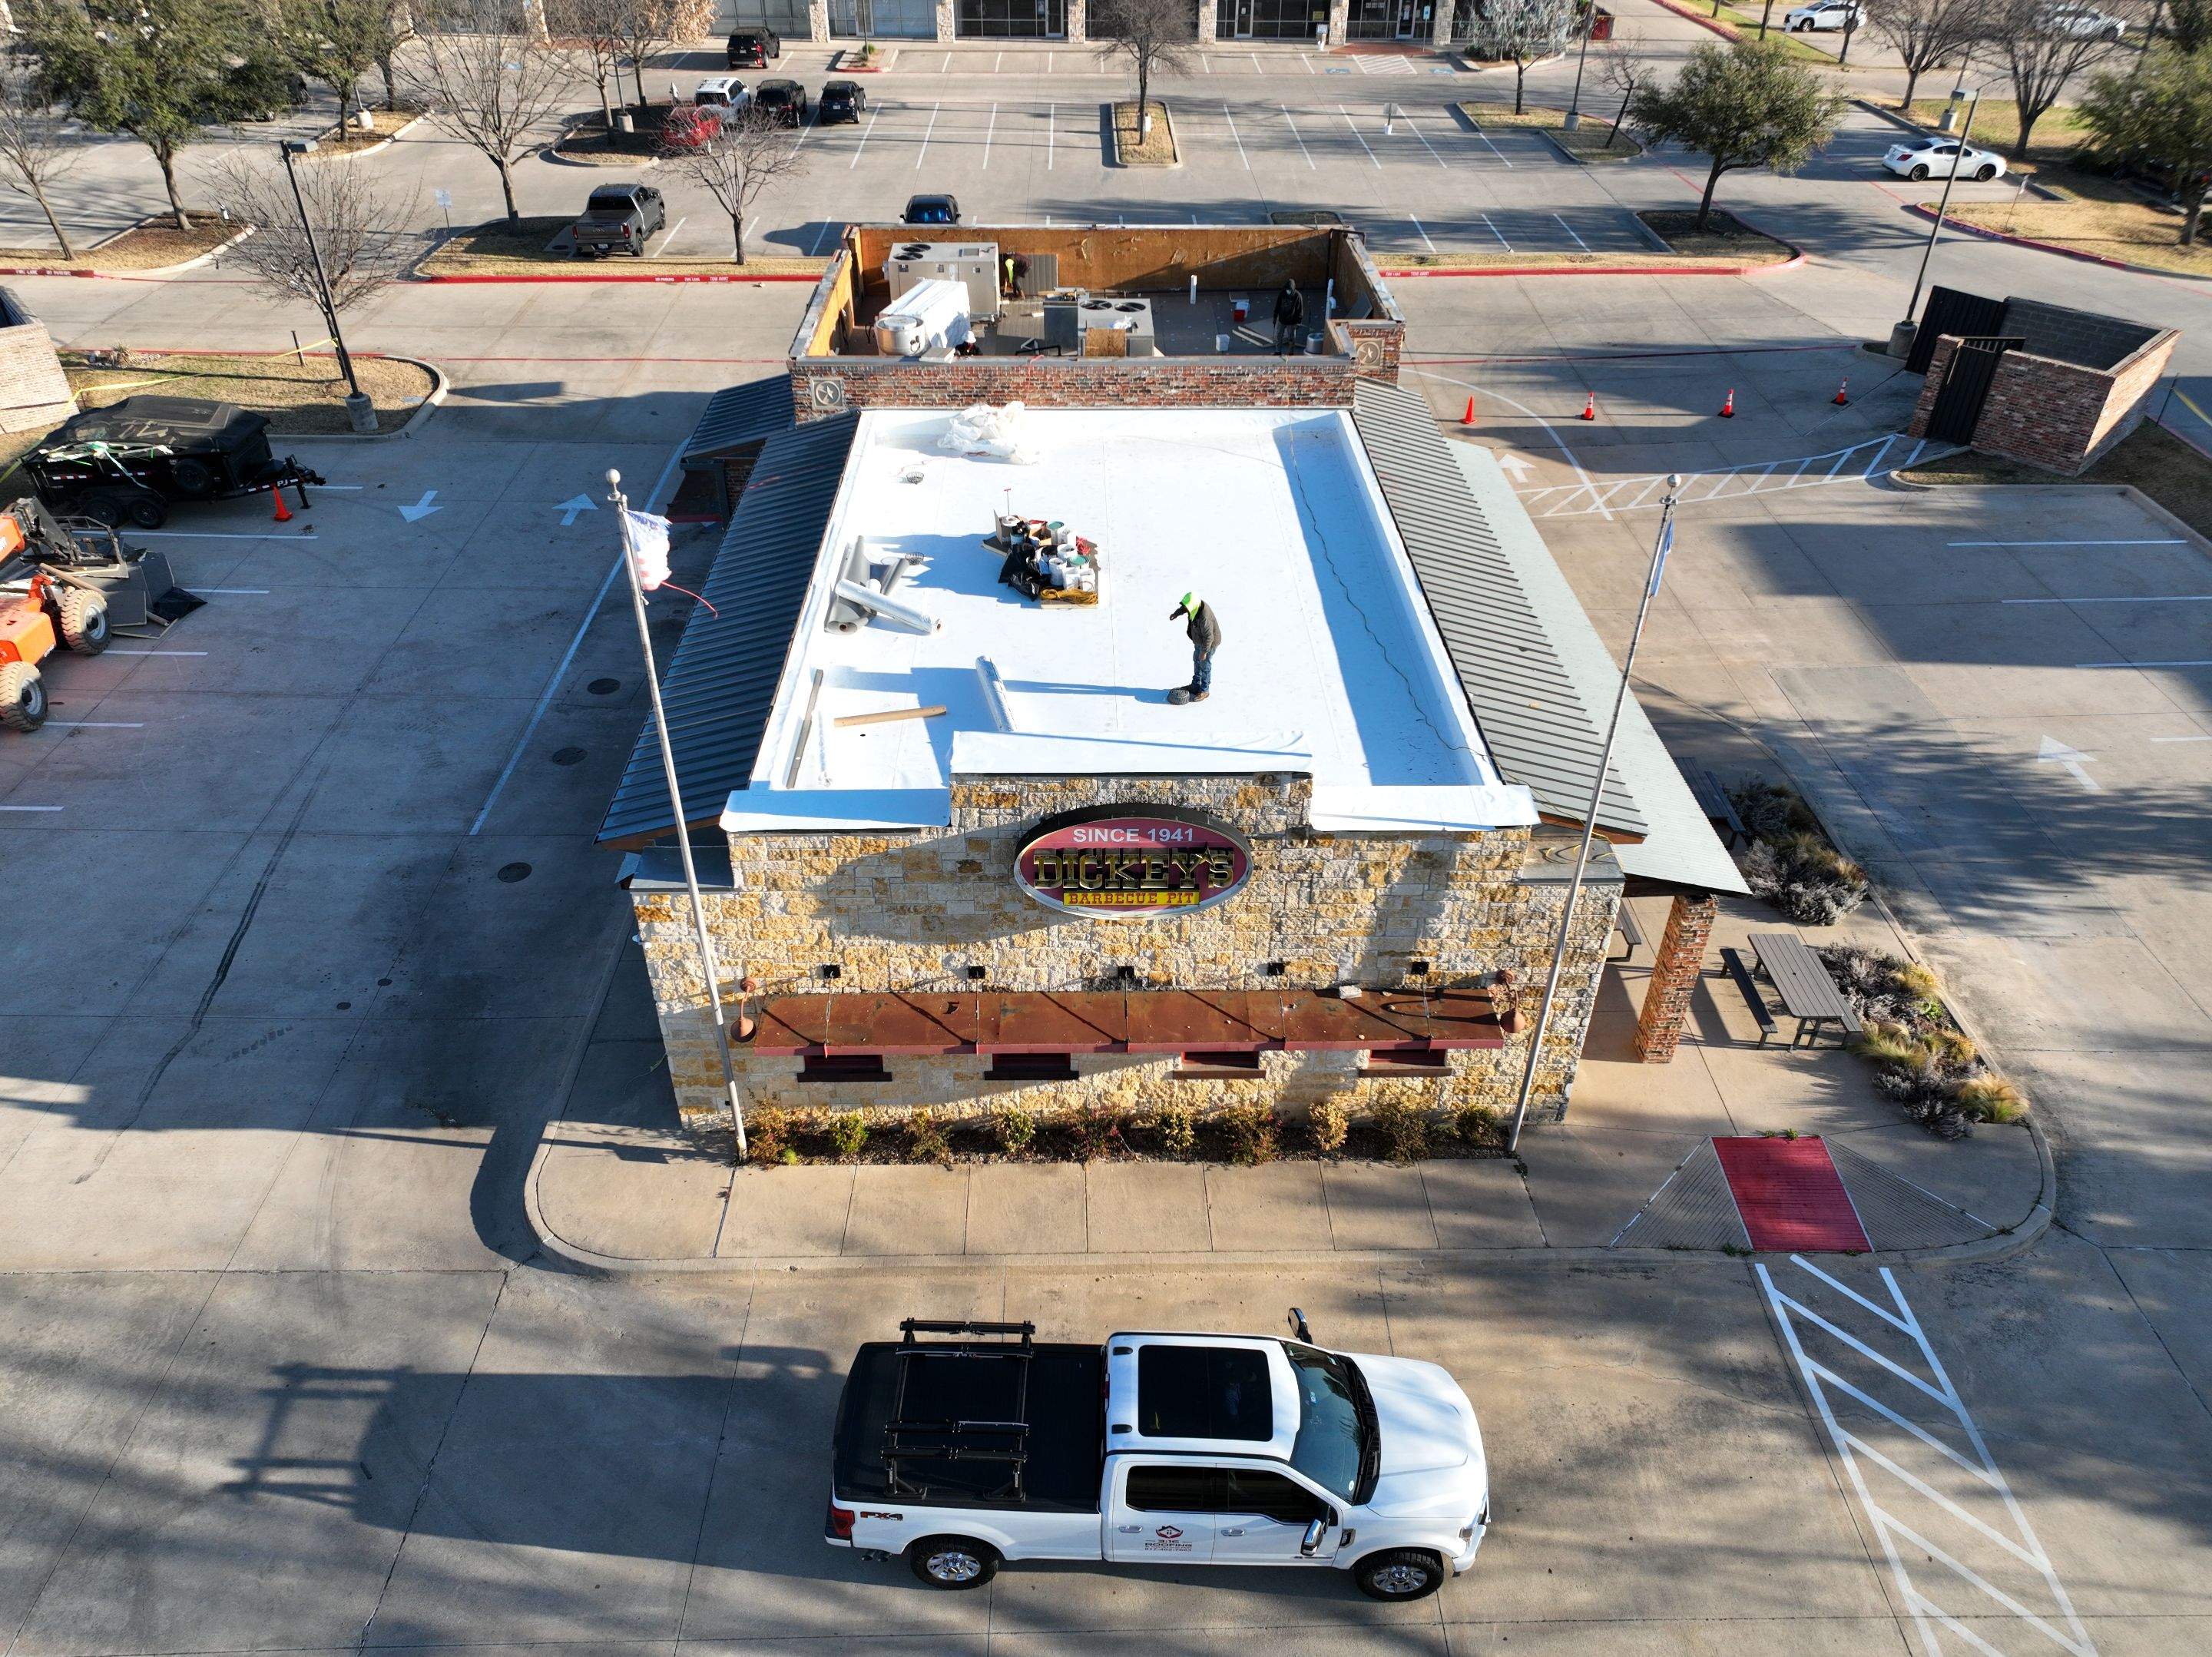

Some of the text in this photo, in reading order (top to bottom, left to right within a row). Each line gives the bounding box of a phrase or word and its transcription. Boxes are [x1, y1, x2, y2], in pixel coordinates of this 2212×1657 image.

[1073, 828, 1194, 843] SINCE 1941
[1034, 847, 1235, 889] DICKEY'S
[1069, 893, 1194, 904] BARBECUE PIT
[860, 1511, 903, 1521] FX4
